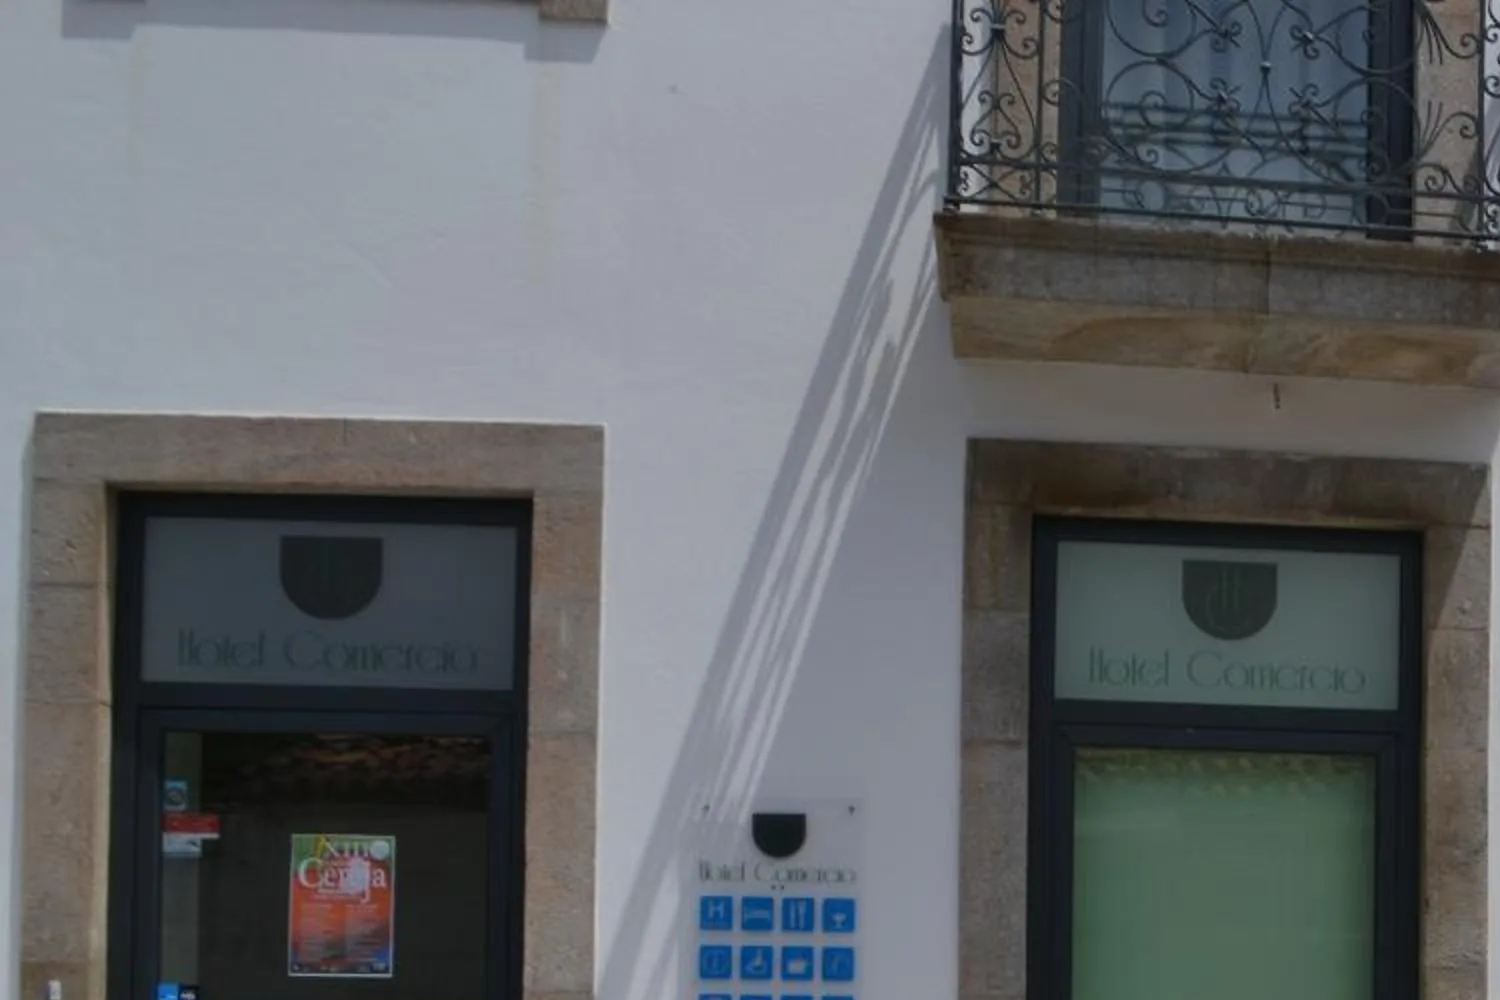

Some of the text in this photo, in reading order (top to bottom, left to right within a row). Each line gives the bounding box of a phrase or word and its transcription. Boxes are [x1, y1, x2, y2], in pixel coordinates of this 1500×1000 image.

[176, 628, 267, 669] Hotel
[1089, 644, 1170, 687] Hotel
[299, 857, 388, 903] Cerja
